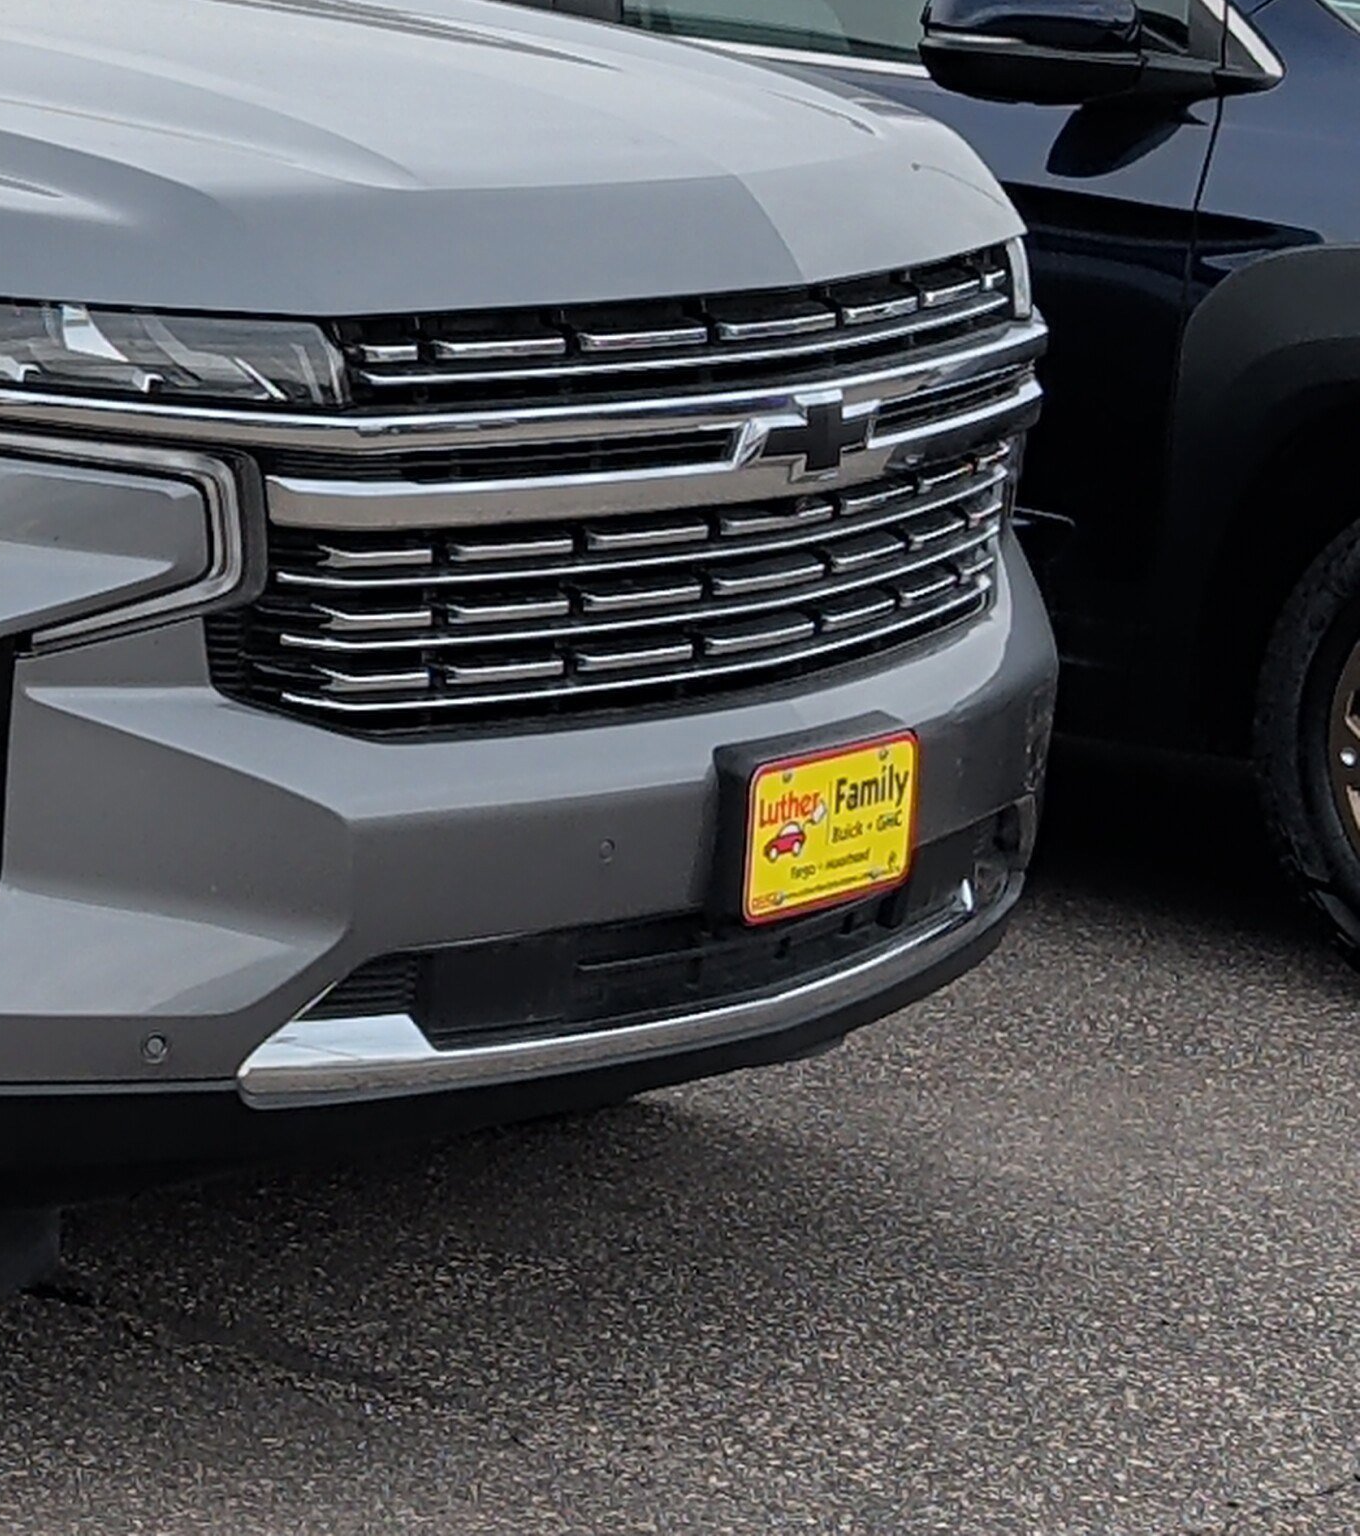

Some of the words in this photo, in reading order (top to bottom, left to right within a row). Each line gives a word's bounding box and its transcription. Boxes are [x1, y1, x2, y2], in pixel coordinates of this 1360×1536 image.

[834, 764, 909, 814] Family
[758, 790, 821, 829] Luther
[832, 824, 863, 842] Buick
[876, 812, 902, 831] GMC
